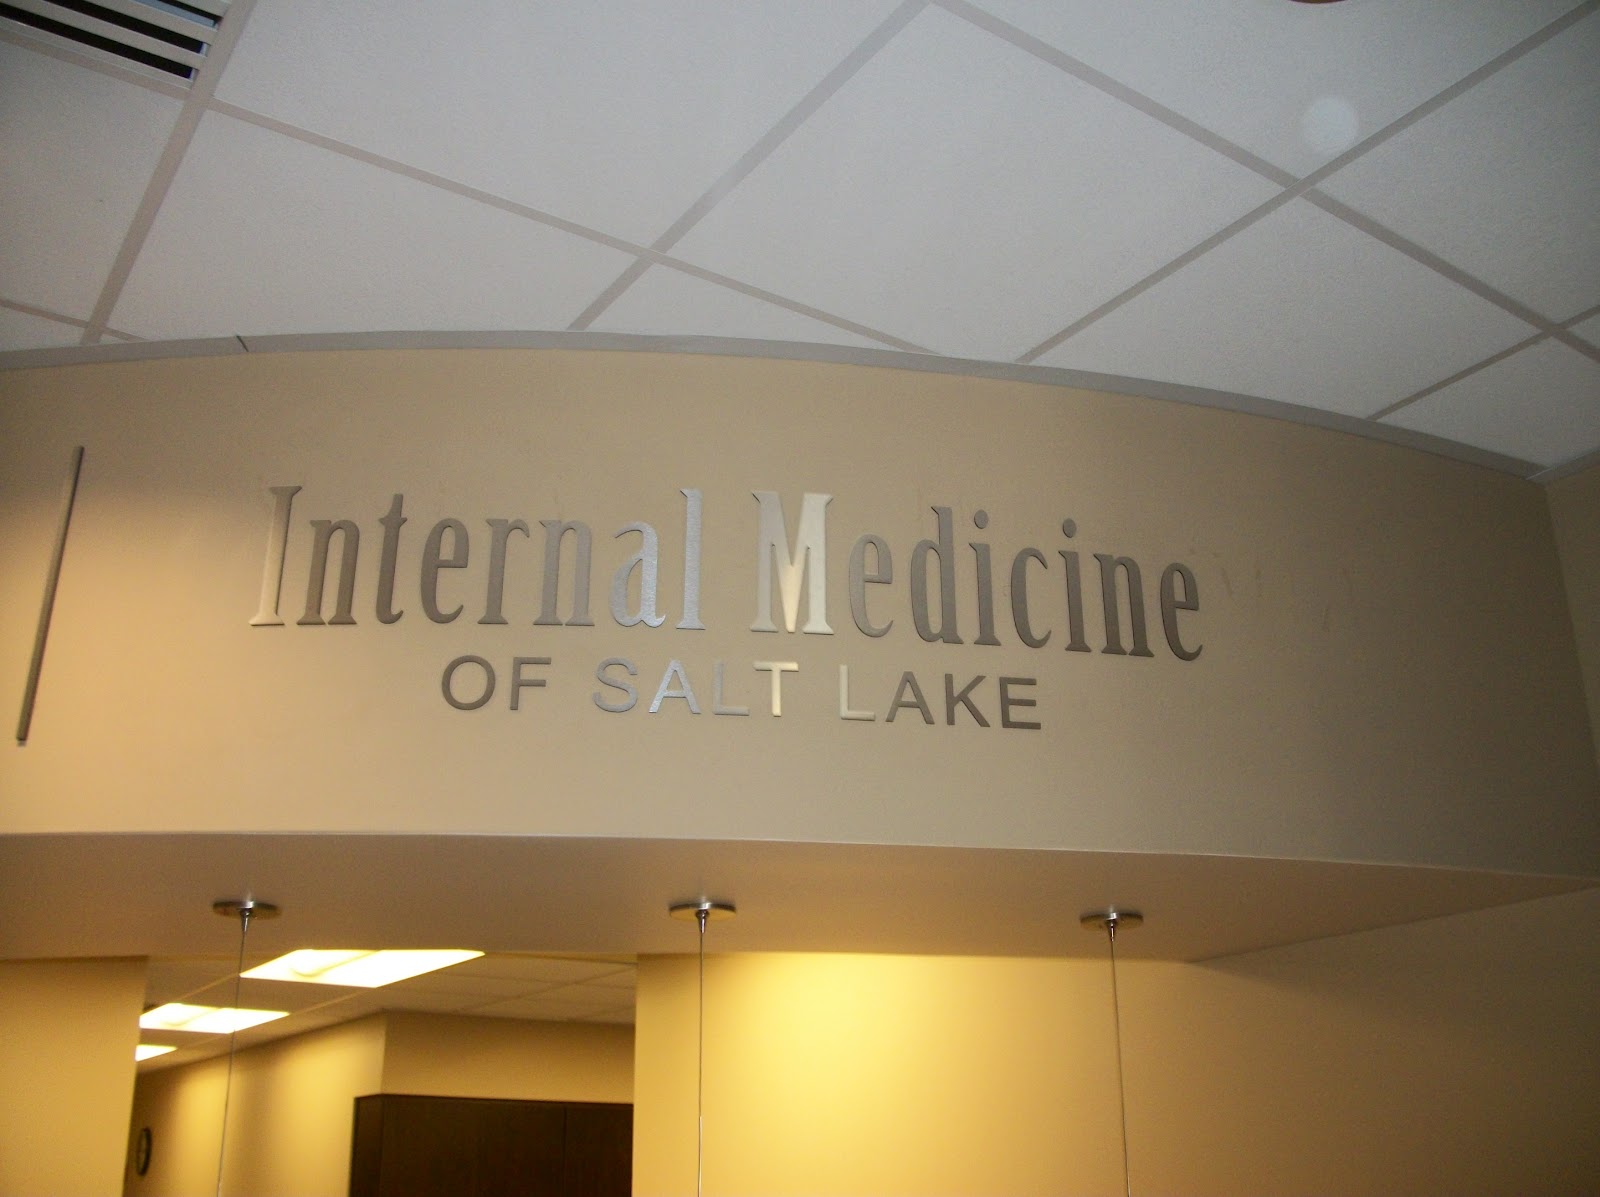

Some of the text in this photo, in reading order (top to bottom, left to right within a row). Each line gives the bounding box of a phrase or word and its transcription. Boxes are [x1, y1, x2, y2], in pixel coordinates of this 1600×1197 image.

[250, 486, 1203, 660] Internal Medicine
[442, 655, 1041, 730] OF SALT LAKE
